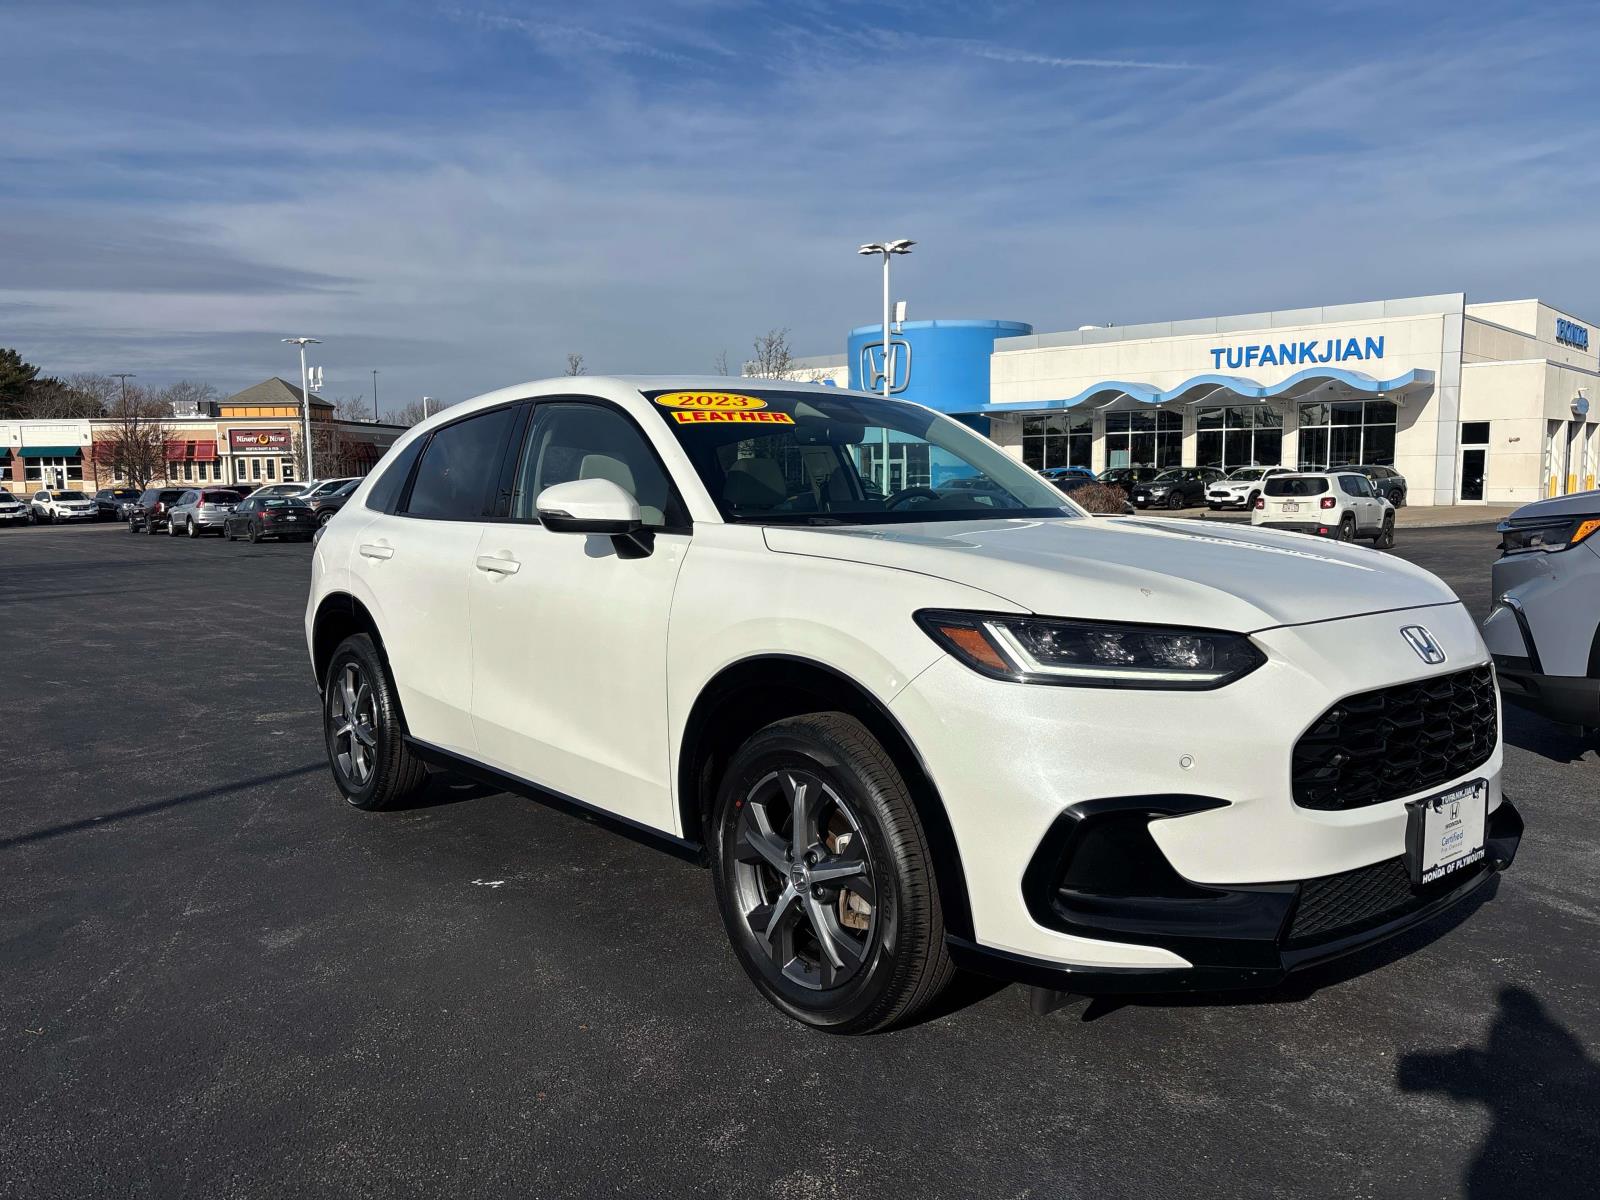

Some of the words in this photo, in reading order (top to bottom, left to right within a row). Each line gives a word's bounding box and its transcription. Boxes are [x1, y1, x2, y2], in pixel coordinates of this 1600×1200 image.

[1210, 335, 1385, 369] TUFANKJIAN
[678, 395, 749, 407] 2023
[677, 411, 789, 423] LEATHER
[269, 435, 285, 443] Nine
[1441, 786, 1475, 805] TUFANKJIAN
[1441, 829, 1463, 846] Certified
[1422, 867, 1445, 884] HONDA
[1446, 862, 1456, 873] OF
[1456, 849, 1485, 870] PLYMOUTH
